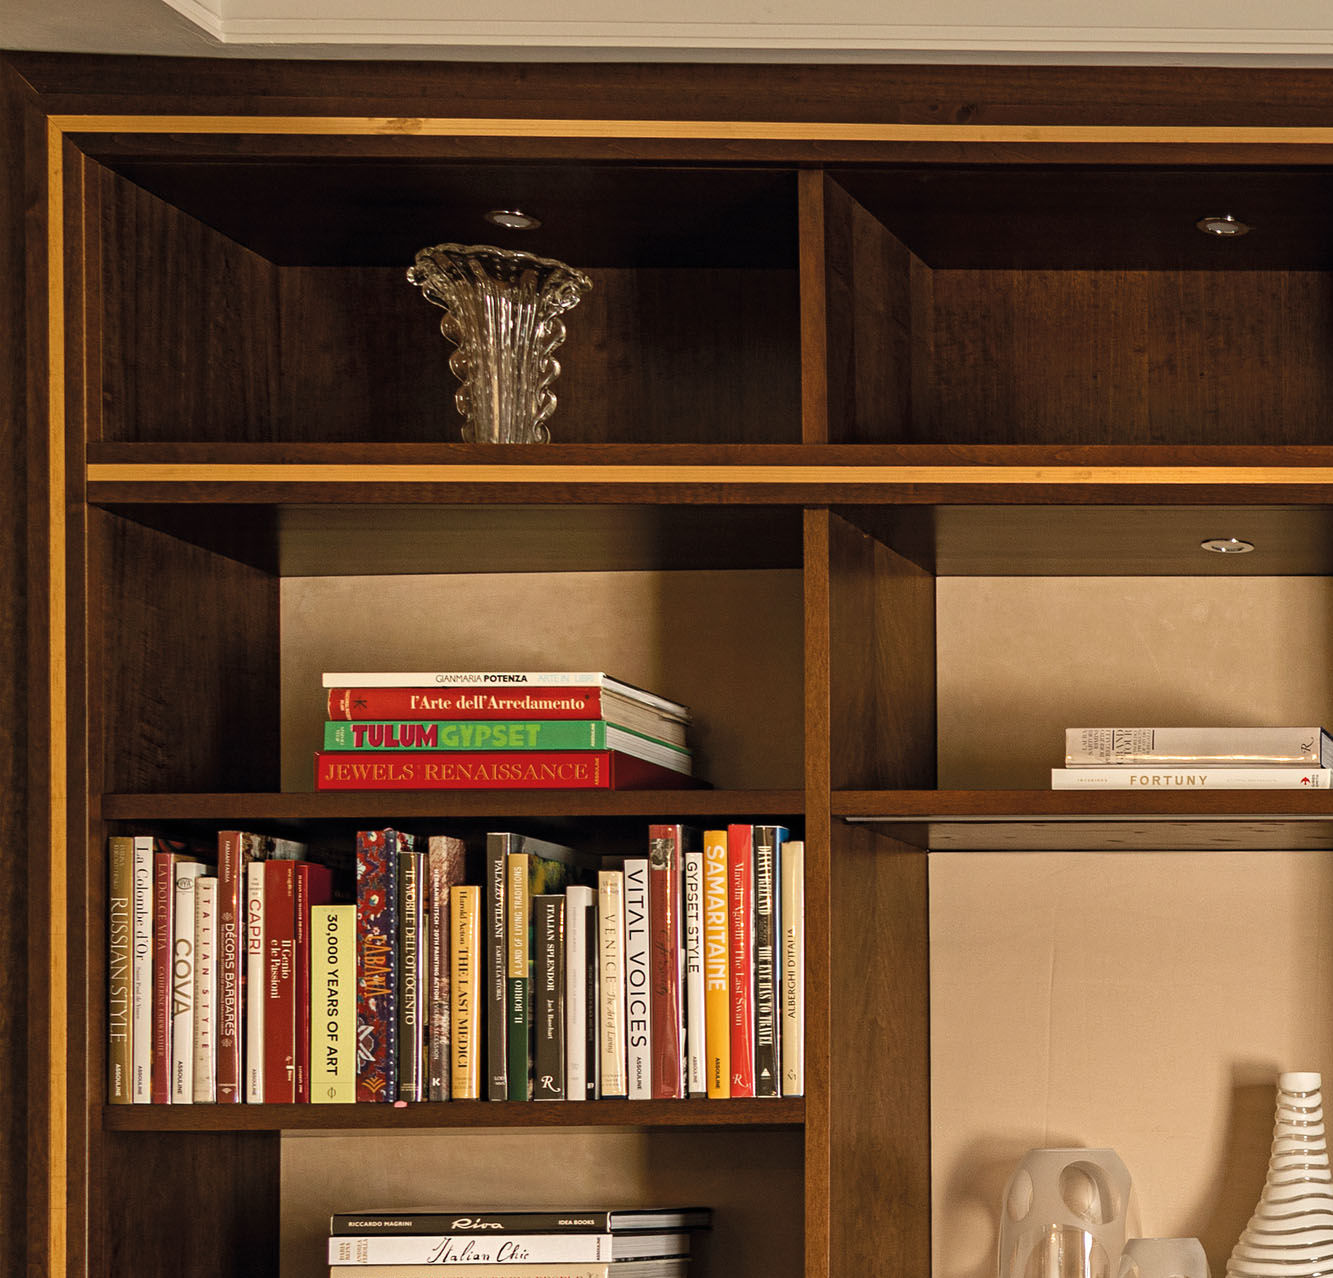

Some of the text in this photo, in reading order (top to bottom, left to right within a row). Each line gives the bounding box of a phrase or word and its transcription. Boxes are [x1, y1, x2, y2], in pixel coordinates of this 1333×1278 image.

[410, 695, 585, 711] l'Arte dell'Arredamento
[435, 675, 527, 683] GIANMARIA POTENZA
[351, 724, 438, 747] TULUM
[441, 724, 541, 747] GYPSET
[325, 763, 588, 781] JEWELS RENAISSANCE
[1130, 776, 1207, 785] FORTUNY
[250, 898, 261, 955] CAPRI
[628, 870, 645, 940] VITAL
[688, 862, 700, 973] GYPSET STYLE
[707, 845, 726, 991] SAMARITAINE
[110, 898, 128, 981] RUSSIAN
[175, 939, 192, 1016] COVA
[225, 924, 235, 1036] DÉCORS BARBARES
[327, 914, 339, 1074] 30,000 YEARS OF ART
[630, 951, 647, 1047] VOICES
[110, 986, 127, 1042] STYLE
[427, 1237, 529, 1264] Italian Chic
[451, 1218, 504, 1229] Riva
